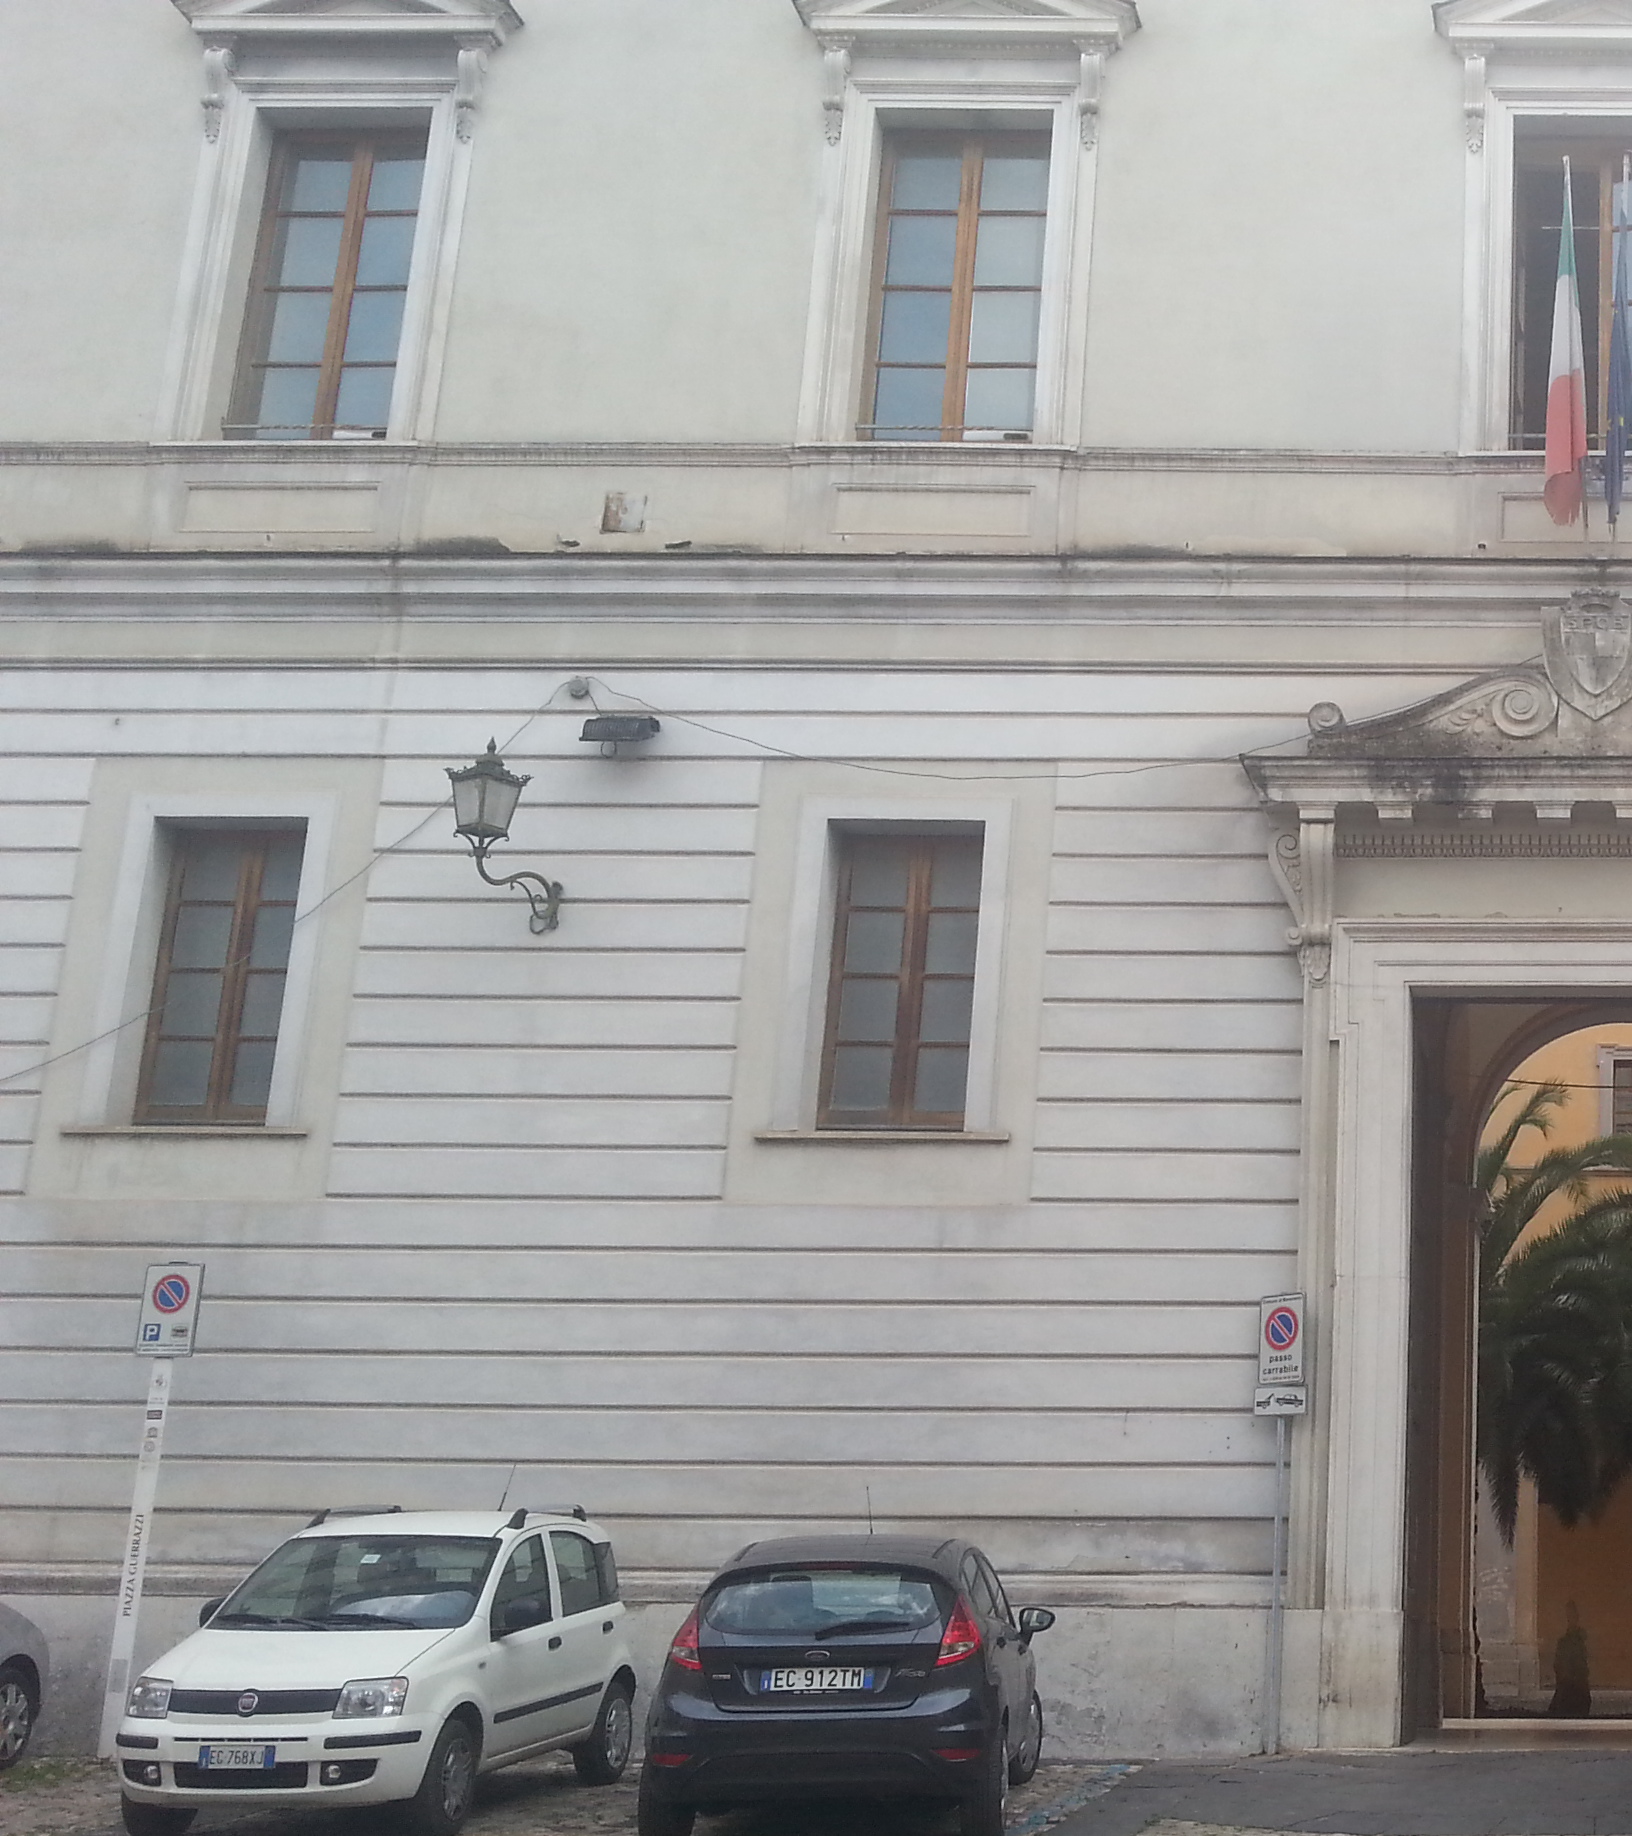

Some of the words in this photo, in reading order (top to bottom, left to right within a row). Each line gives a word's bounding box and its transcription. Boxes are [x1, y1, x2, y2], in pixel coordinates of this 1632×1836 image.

[1269, 1354, 1293, 1364] passo
[1262, 1364, 1299, 1375] carrabile
[128, 1514, 144, 1576] GUERRAZZI
[122, 1578, 135, 1617] PIAZZA
[773, 1669, 797, 1688] EC
[804, 1668, 862, 1688] 912TM
[226, 1750, 265, 1765] 768XJ
